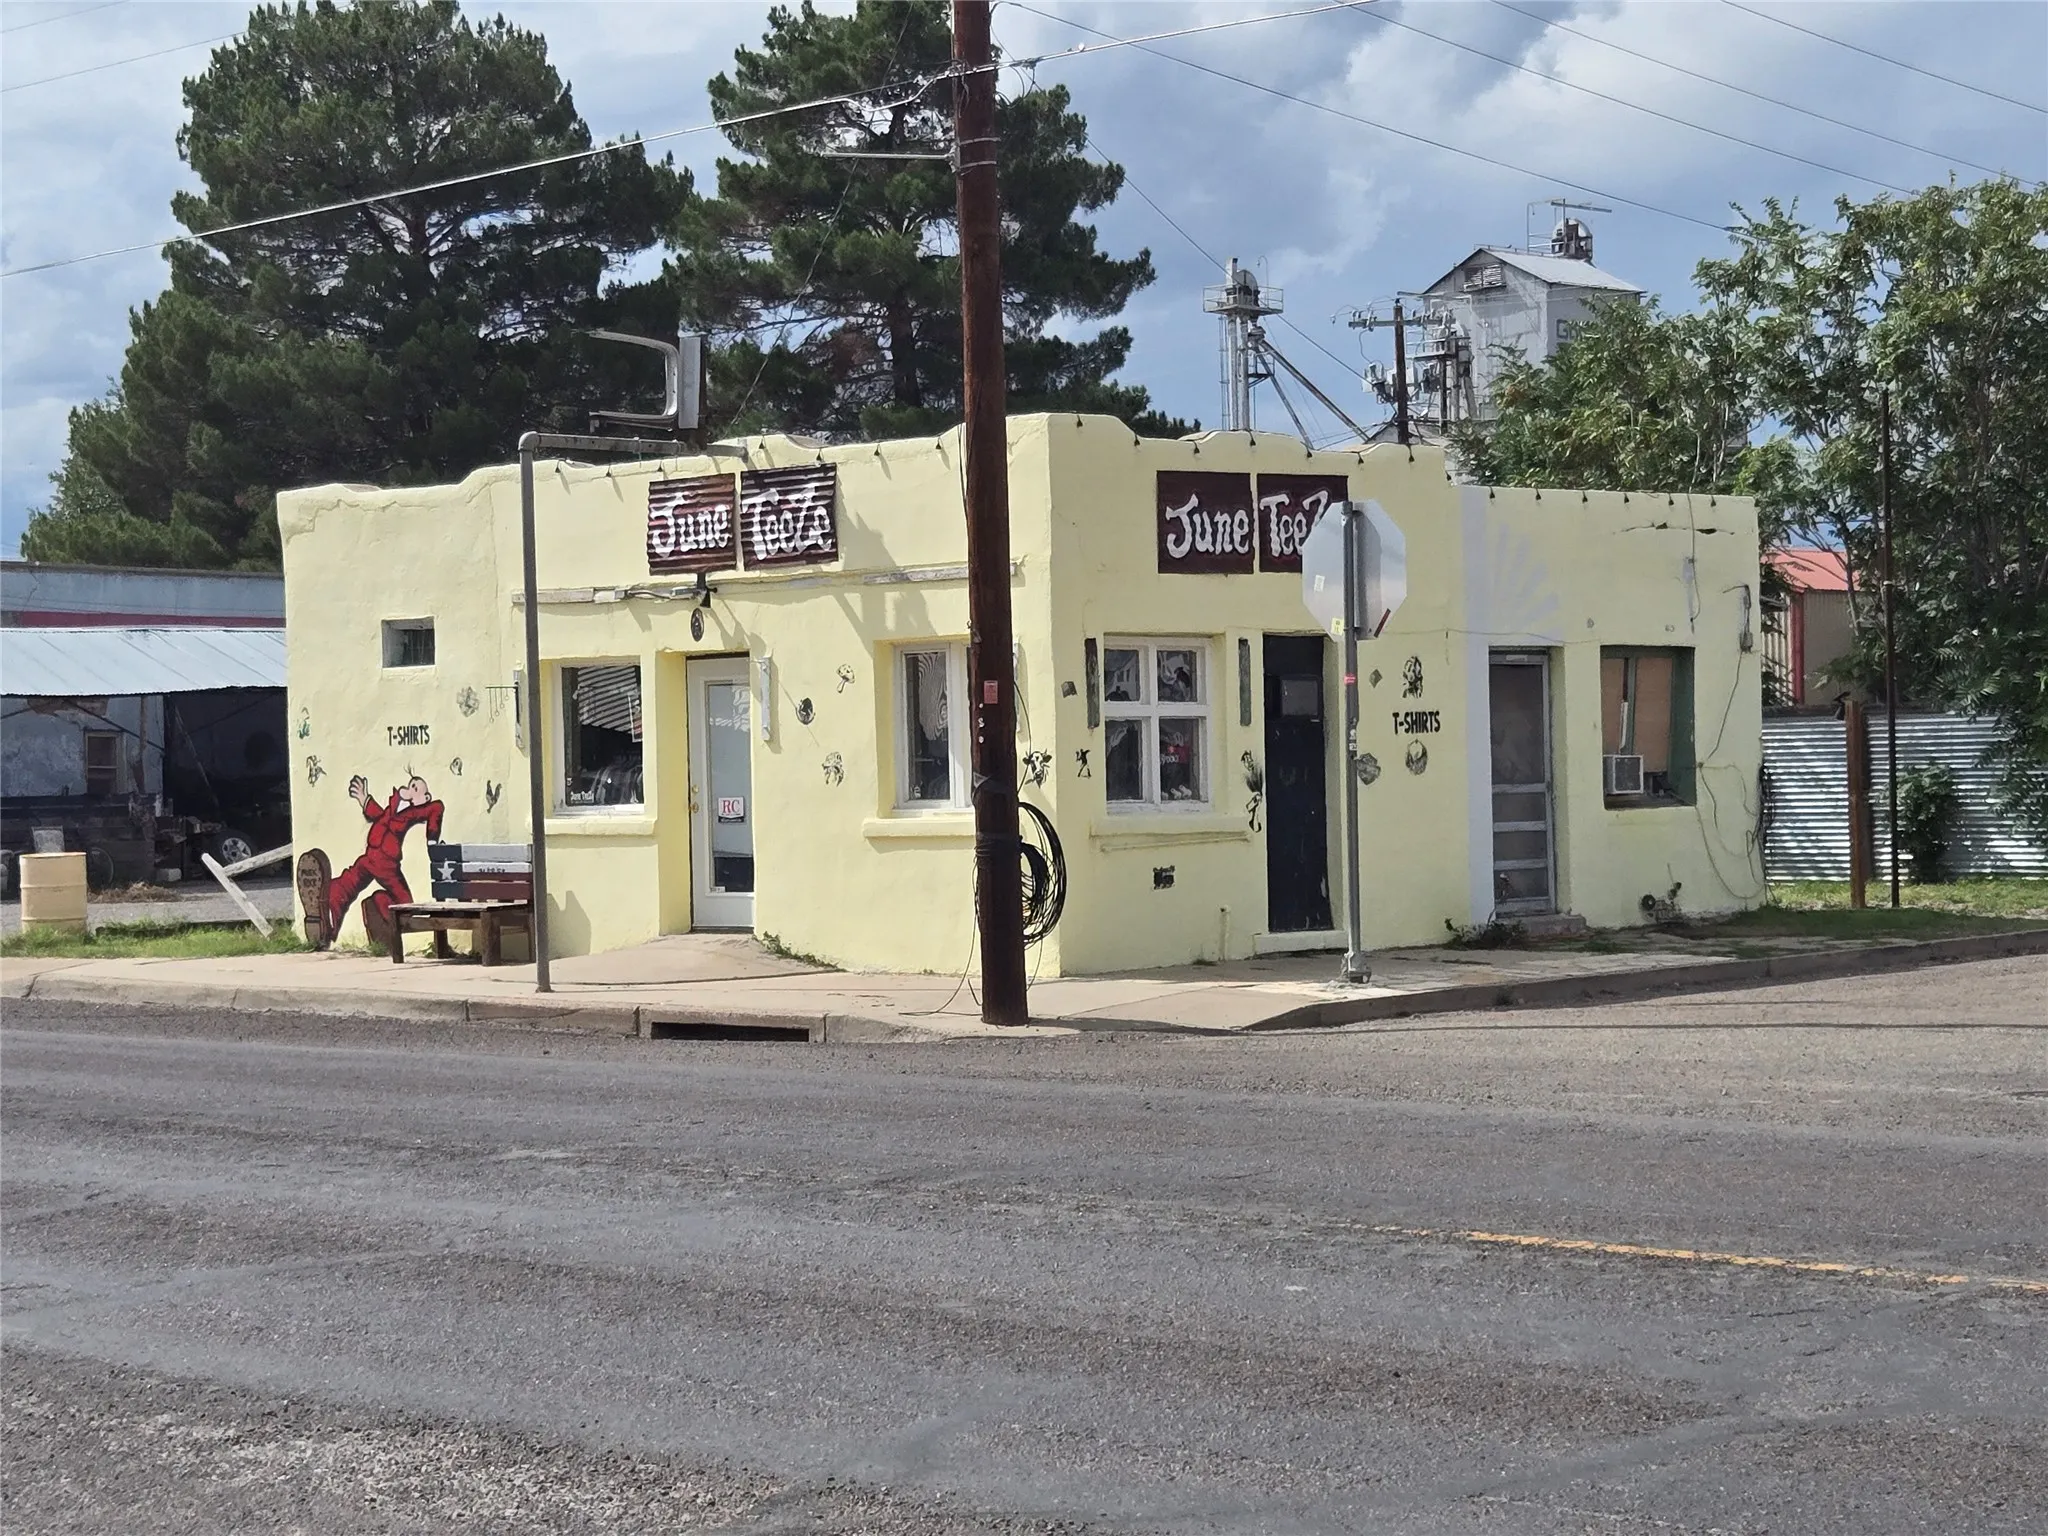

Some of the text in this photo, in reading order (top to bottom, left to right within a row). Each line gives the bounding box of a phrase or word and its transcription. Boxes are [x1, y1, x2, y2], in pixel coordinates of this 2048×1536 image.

[650, 492, 733, 559] June
[1165, 493, 1249, 559] June
[1392, 710, 1441, 735] T-SHIRTS
[387, 724, 430, 747] T-SHIRTS
[722, 799, 741, 814] RC
